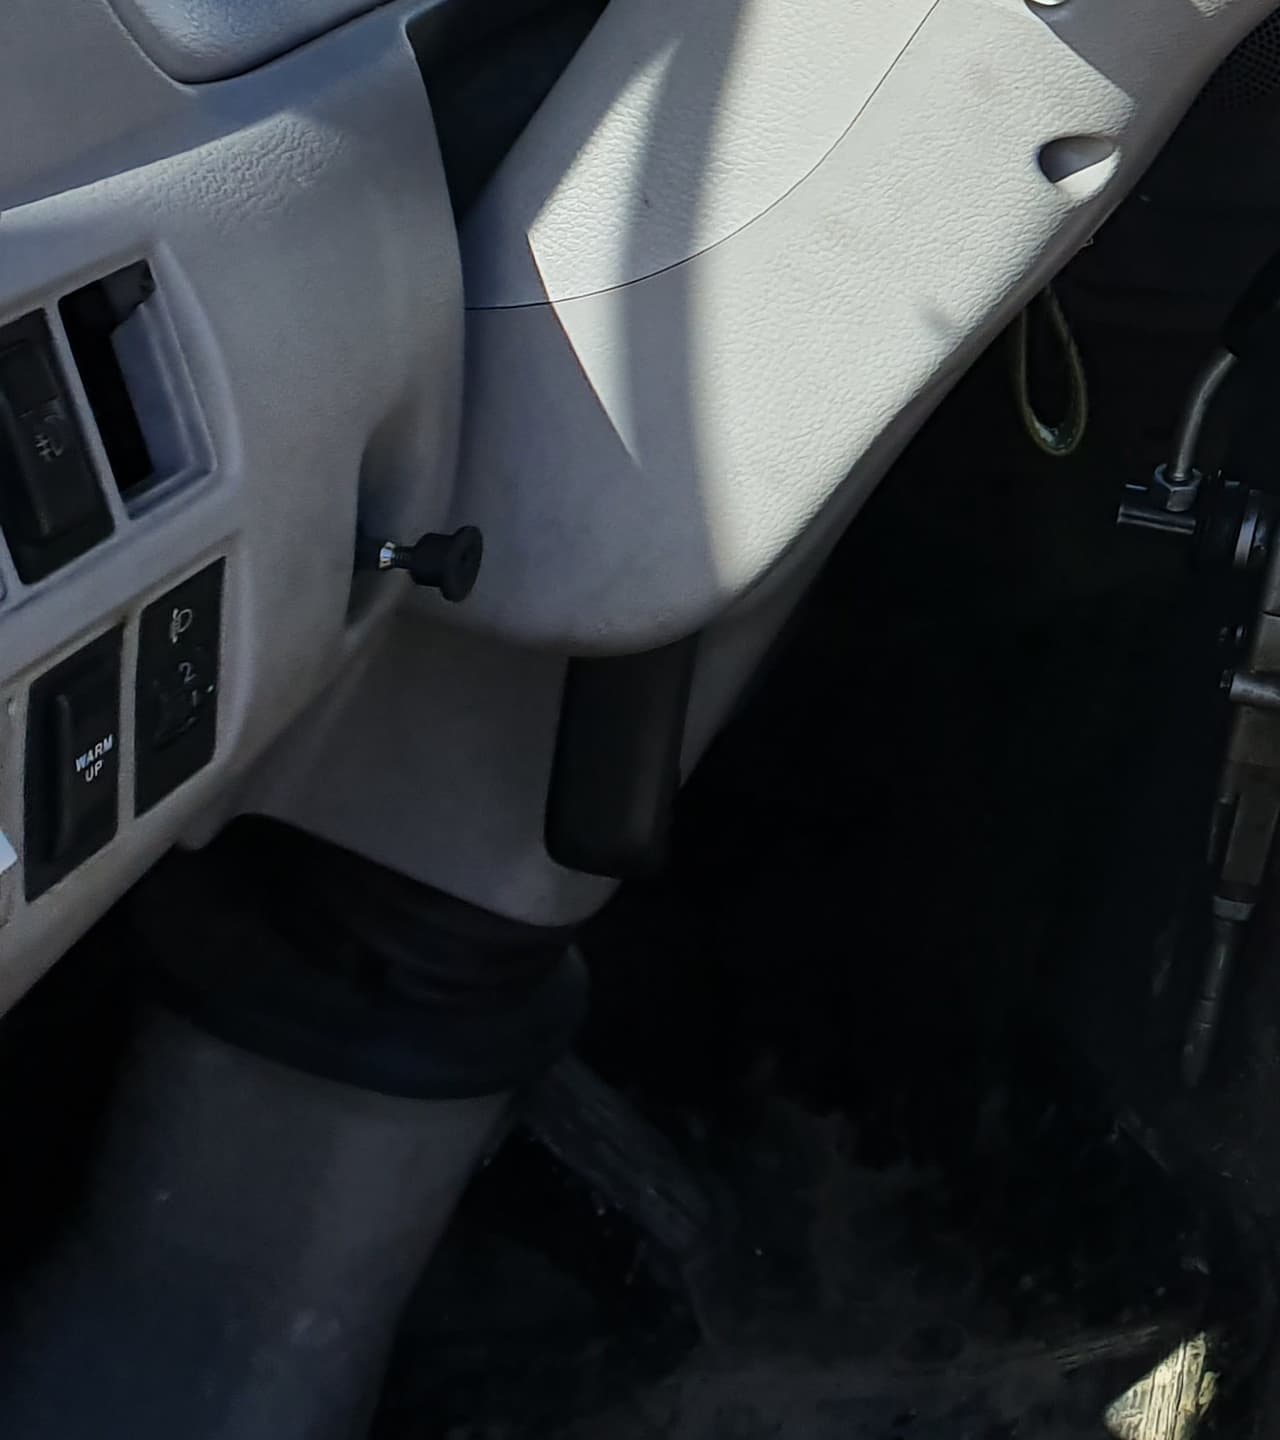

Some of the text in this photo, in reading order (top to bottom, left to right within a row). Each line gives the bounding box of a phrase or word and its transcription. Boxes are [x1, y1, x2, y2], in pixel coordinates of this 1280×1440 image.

[178, 661, 197, 685] 2
[75, 734, 113, 772] WARM
[85, 760, 104, 783] UP
